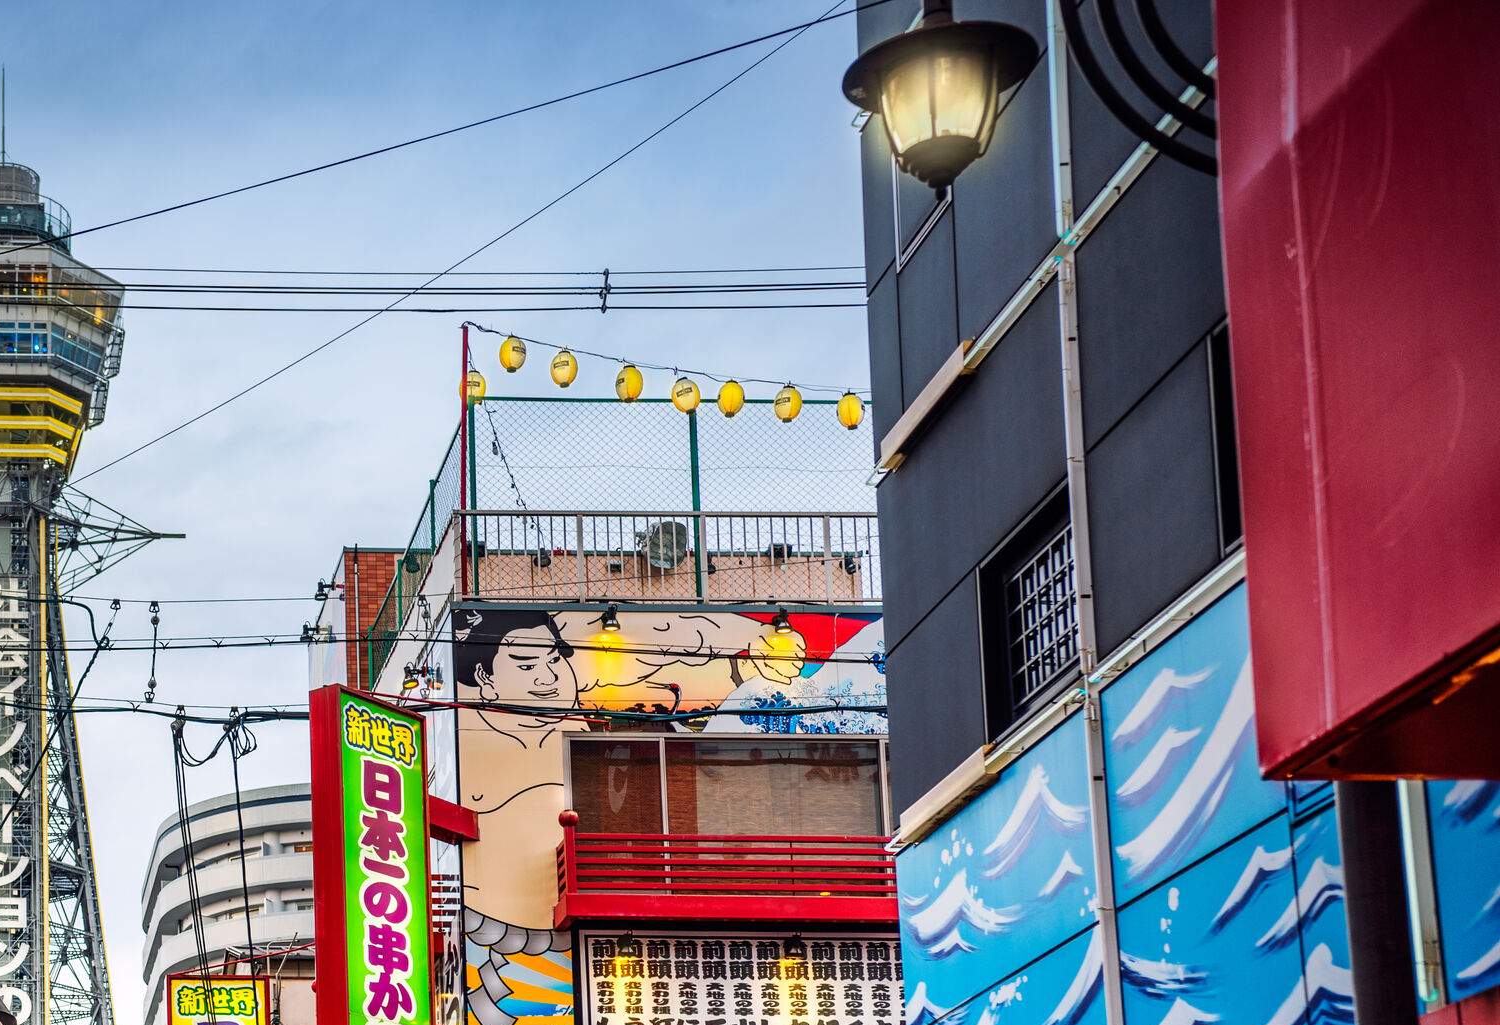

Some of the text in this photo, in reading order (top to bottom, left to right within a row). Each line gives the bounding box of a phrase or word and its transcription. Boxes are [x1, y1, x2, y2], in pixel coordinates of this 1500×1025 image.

[346, 707, 415, 765] 新世界
[592, 939, 616, 978] 前頭
[647, 940, 672, 979] 前頭
[674, 940, 699, 979] 前頭
[701, 940, 727, 980] 前頭
[729, 940, 754, 980] 前頭
[755, 941, 780, 980] 前頭
[812, 942, 837, 981] 前頭
[839, 942, 864, 981] 前頭
[866, 942, 891, 981] 前頭
[177, 987, 257, 1016] 新世界
